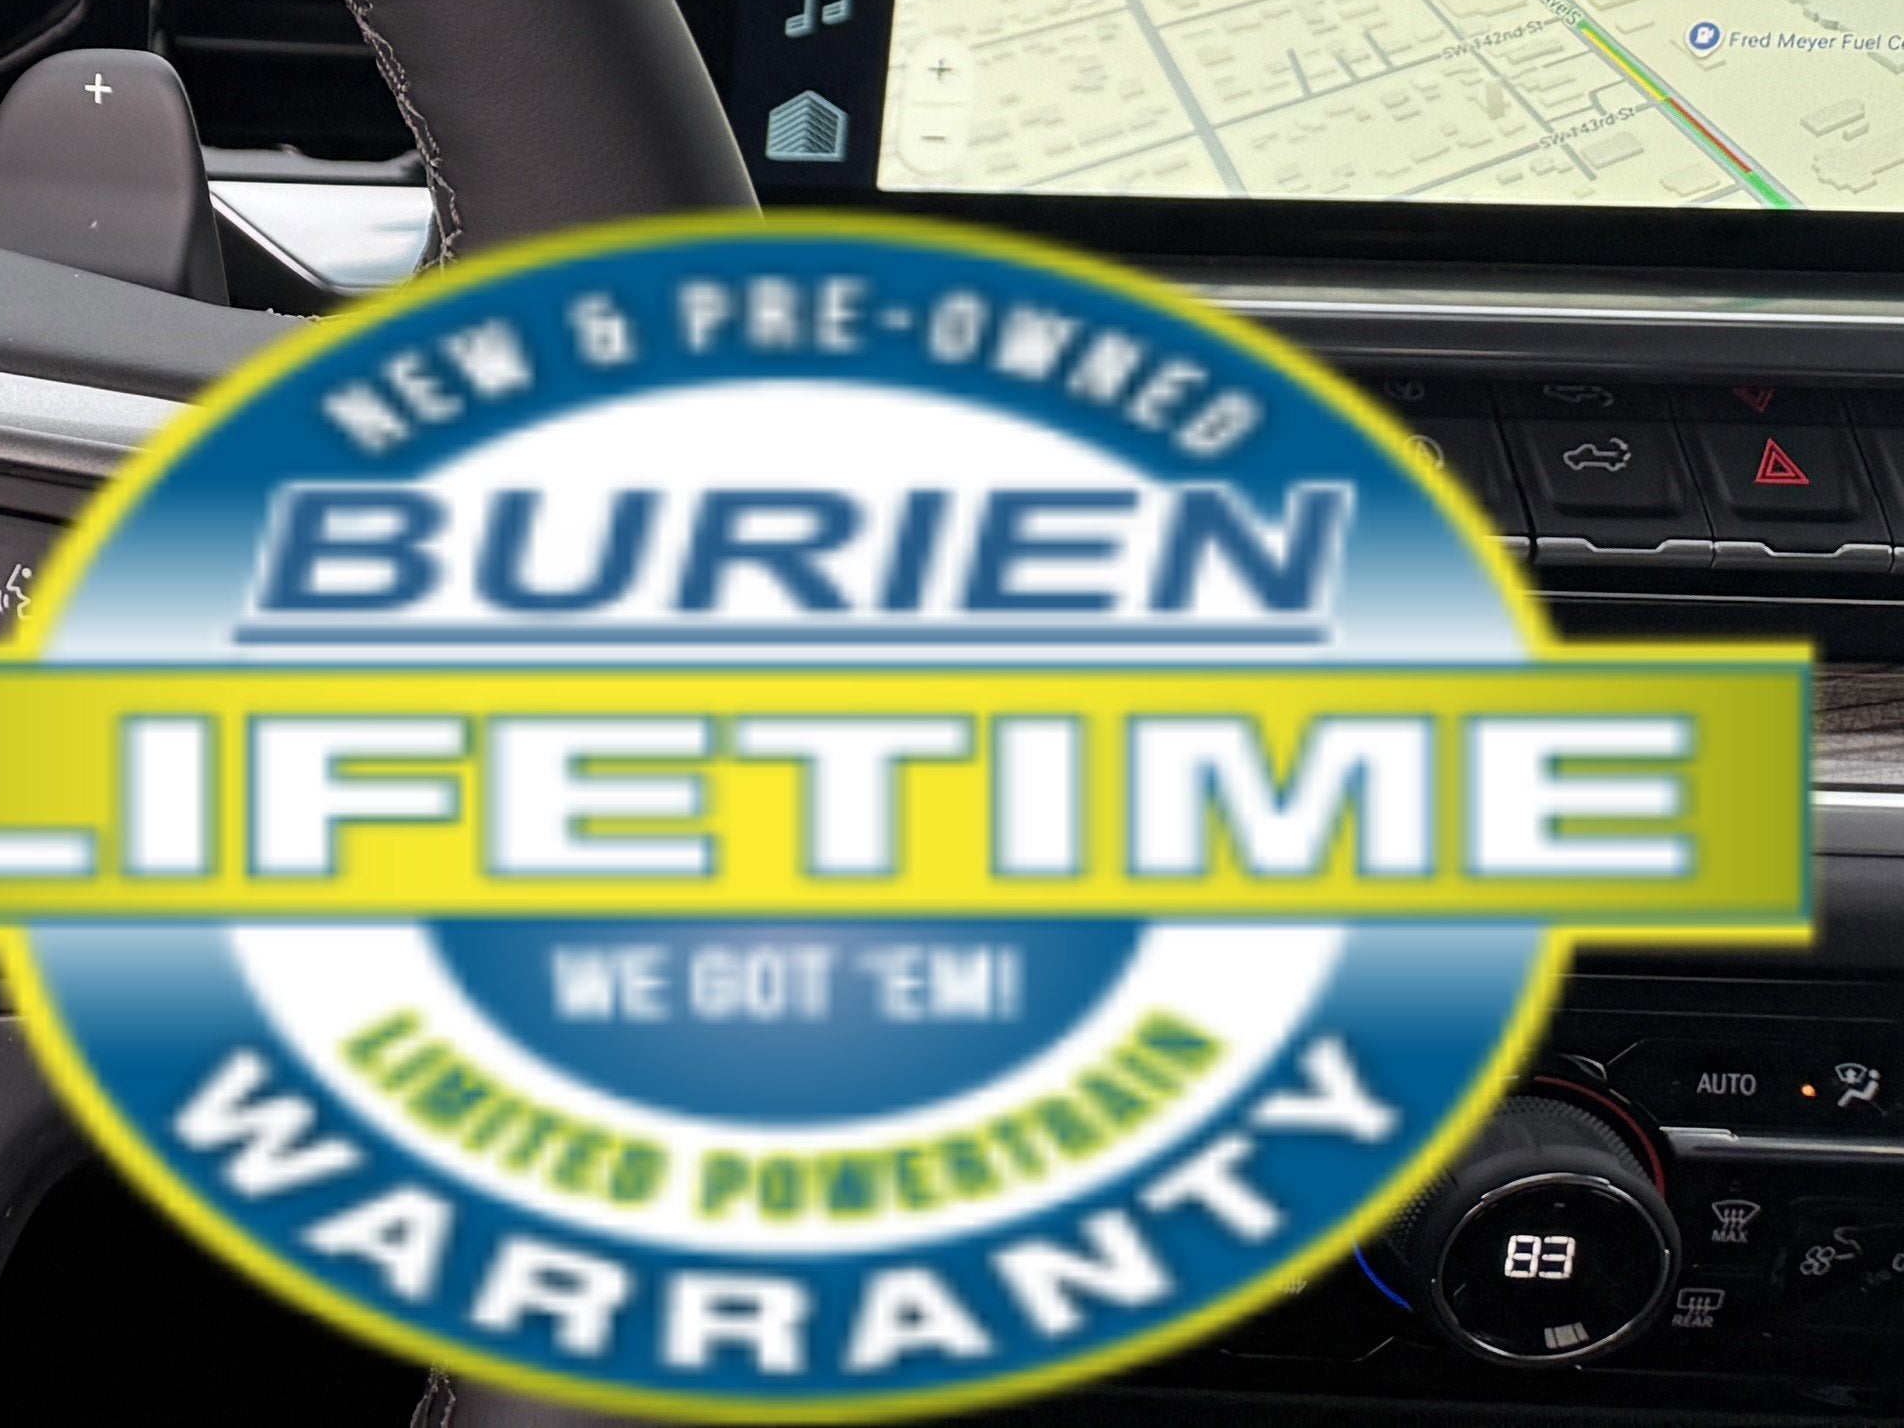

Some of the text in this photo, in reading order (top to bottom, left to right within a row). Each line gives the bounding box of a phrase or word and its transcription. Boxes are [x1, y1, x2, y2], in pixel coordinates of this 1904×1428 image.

[1442, 20, 1542, 60] SW 142nd St
[1729, 31, 1771, 48] Fred
[1777, 33, 1836, 52] Meyer
[1841, 33, 1882, 50] Fuel
[1539, 106, 1635, 149] SW 143rd St
[1696, 1072, 1756, 1096] AUTO
[1710, 1227, 1749, 1244] MAX
[1504, 1234, 1576, 1279] 83
[1671, 1312, 1714, 1328] REAR
